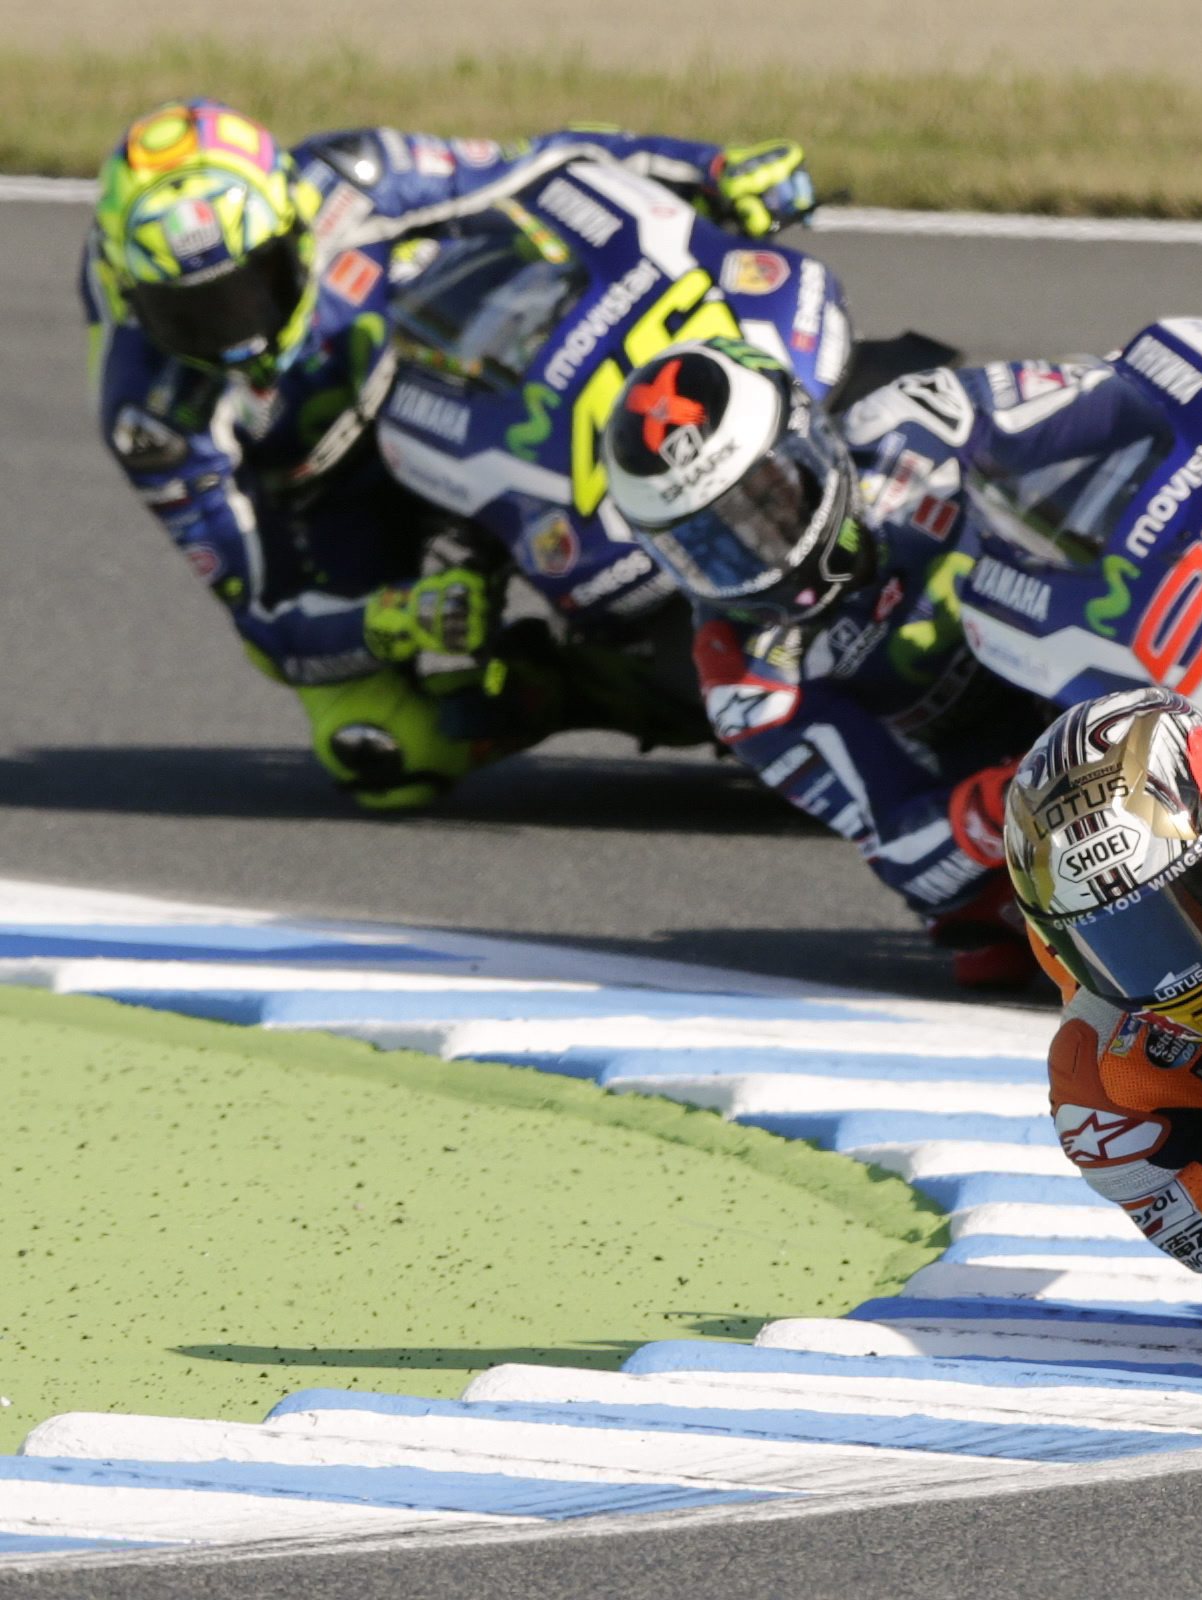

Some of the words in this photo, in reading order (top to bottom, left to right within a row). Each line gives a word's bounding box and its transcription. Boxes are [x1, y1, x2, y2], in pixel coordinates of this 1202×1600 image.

[972, 555, 1051, 622] YAMAHA
[1033, 776, 1129, 839] LOTUS
[1066, 832, 1130, 877] SHOEI
[1103, 893, 1142, 916] YOU
[1131, 1190, 1178, 1225] PSOL
